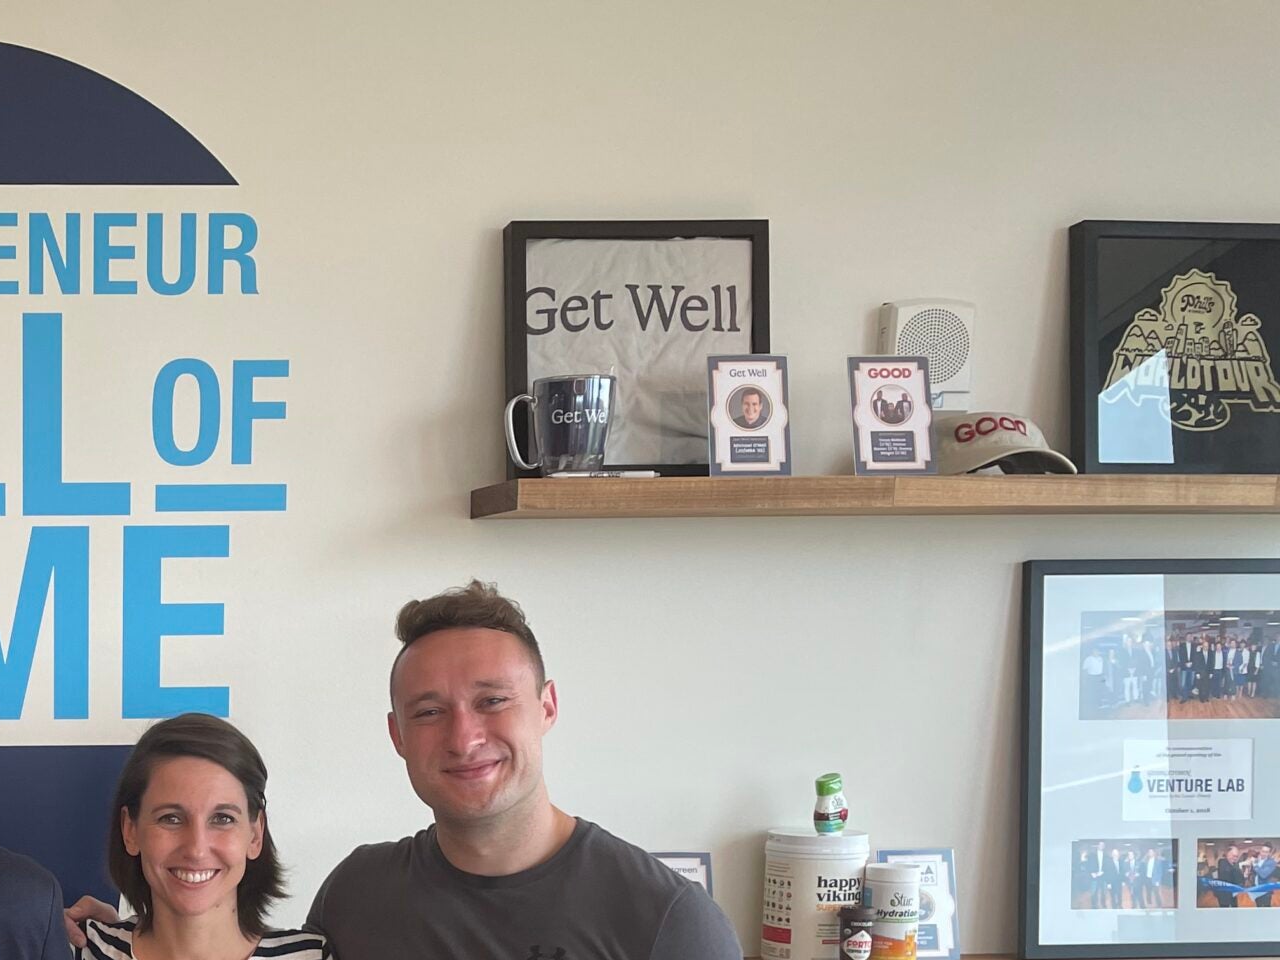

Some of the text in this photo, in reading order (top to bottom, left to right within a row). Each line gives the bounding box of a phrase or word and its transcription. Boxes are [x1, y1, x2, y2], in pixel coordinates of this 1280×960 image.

[525, 284, 741, 336] Get Well
[729, 369, 767, 378] Get Well
[868, 368, 912, 379] GOOD
[151, 358, 290, 466] OF
[552, 409, 582, 425] Get
[1147, 779, 1245, 793] VENTURE LAB
[817, 875, 862, 892] happy
[817, 890, 862, 905] viking
